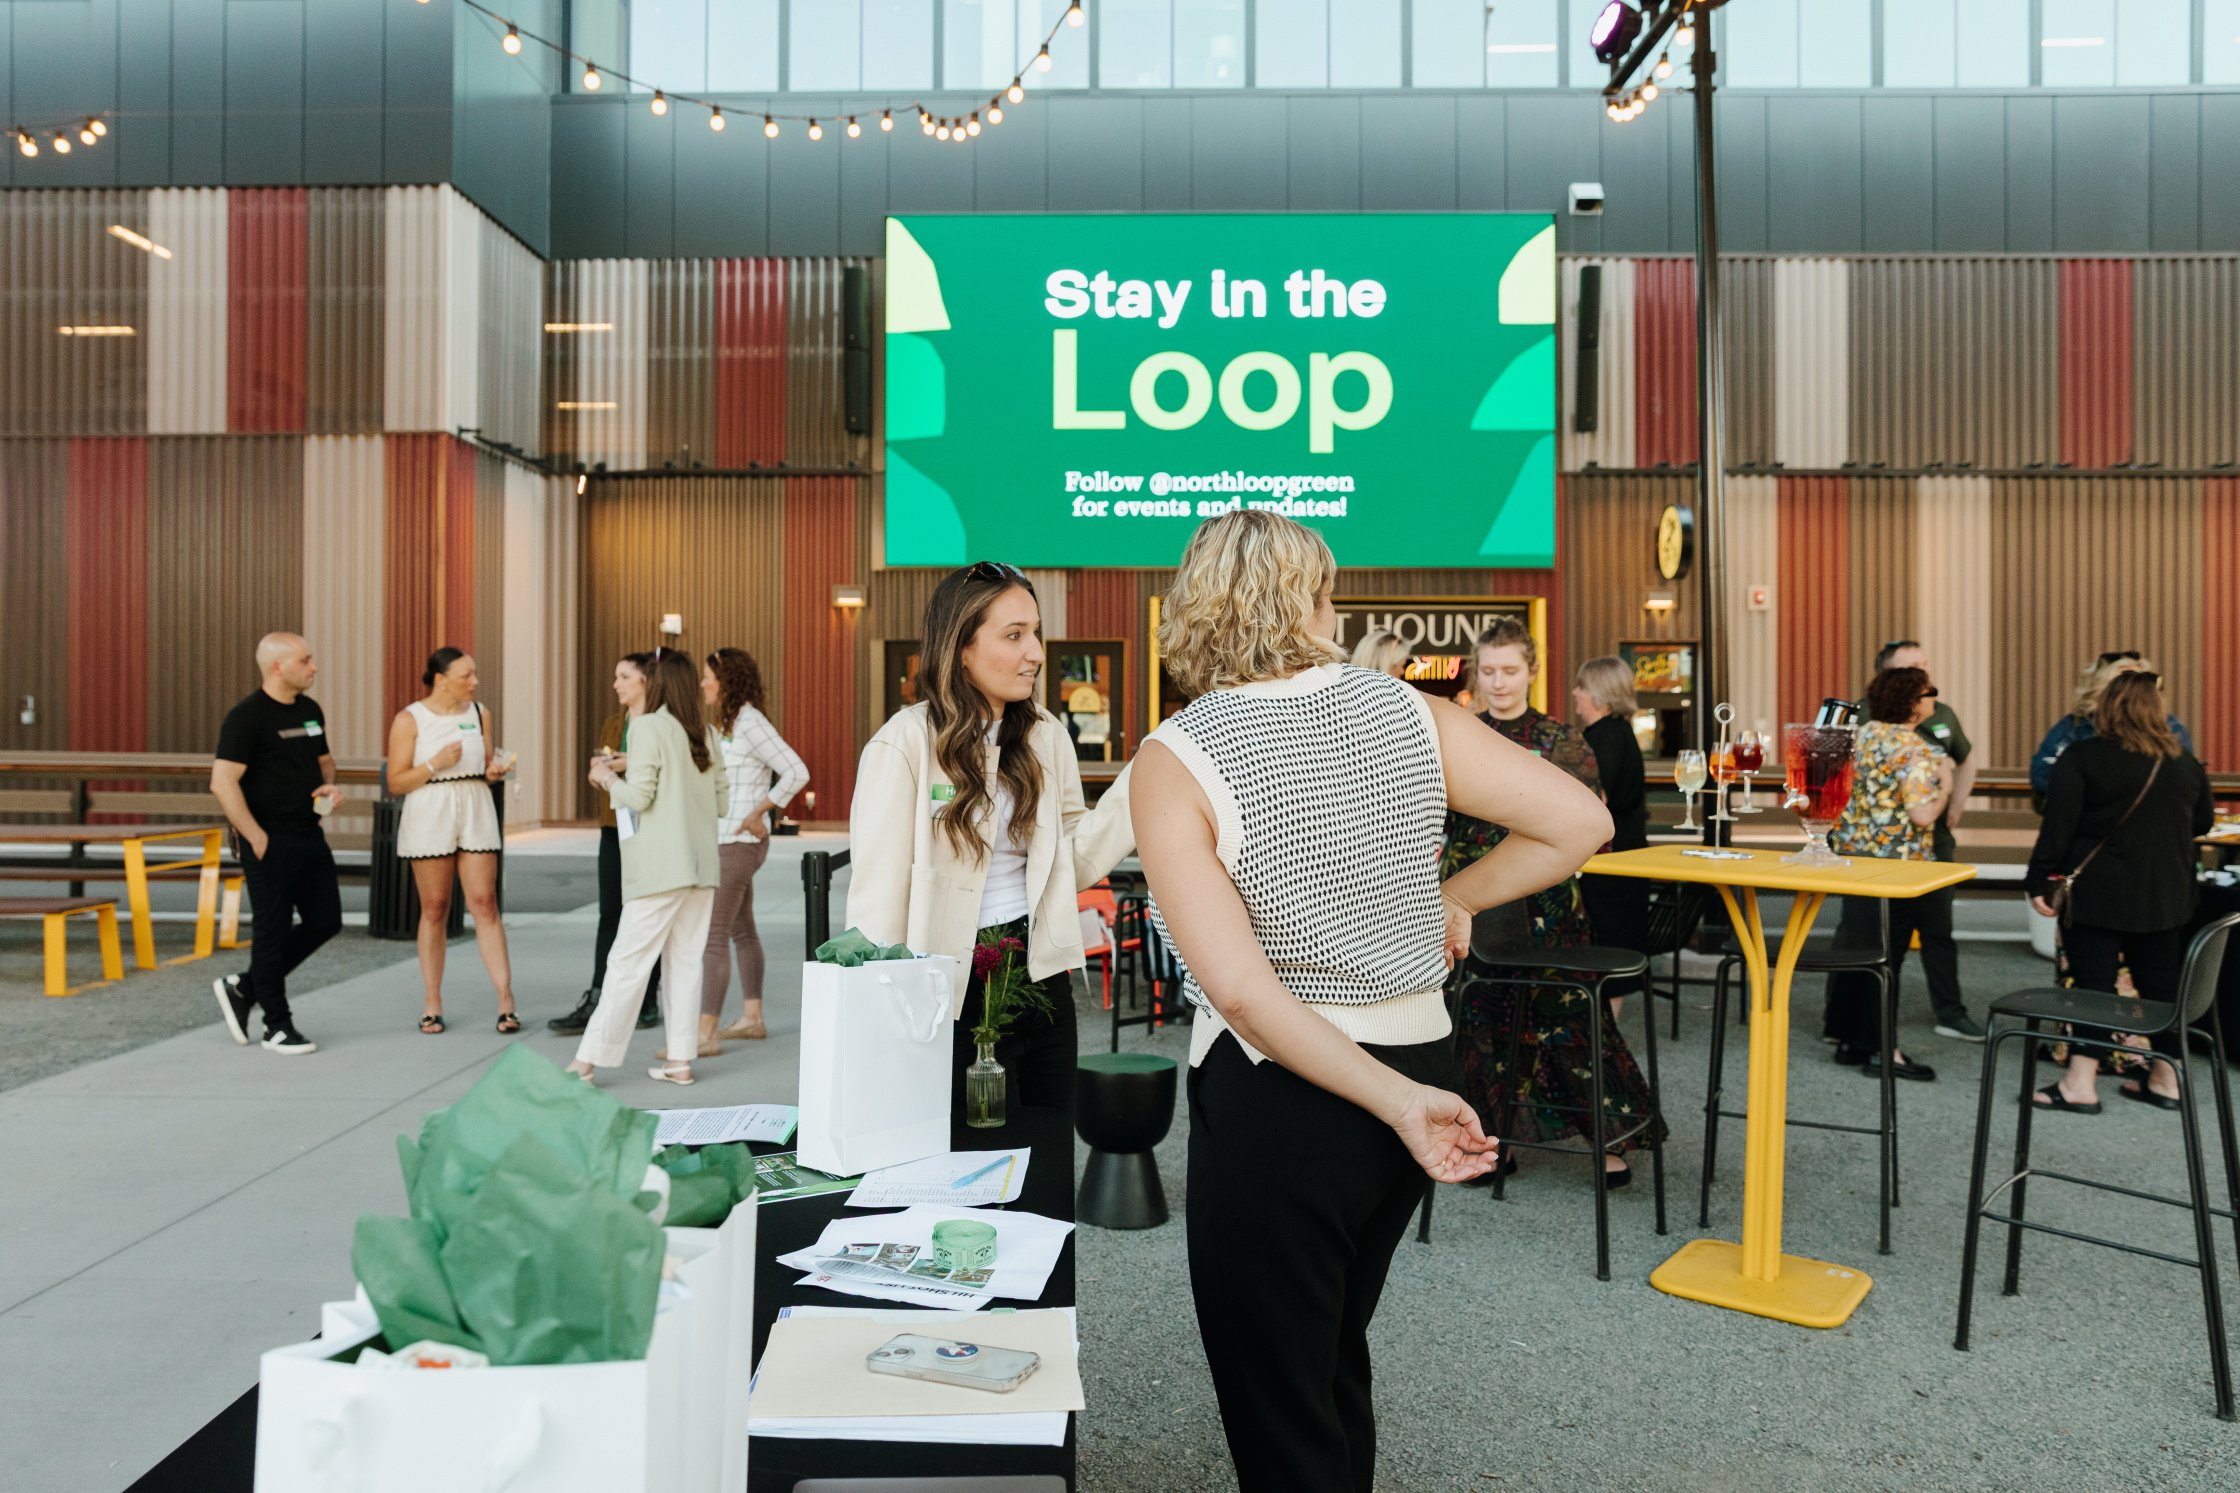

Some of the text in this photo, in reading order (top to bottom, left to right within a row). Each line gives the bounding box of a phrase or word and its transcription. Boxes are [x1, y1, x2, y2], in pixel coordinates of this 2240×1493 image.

[1044, 268, 1387, 329] Stay in the
[1052, 328, 1394, 454] Loop
[1064, 470, 1356, 498] Follow @northloopgreen
[1071, 494, 1110, 517] for
[1113, 496, 1192, 518] events
[1196, 495, 1242, 517] and
